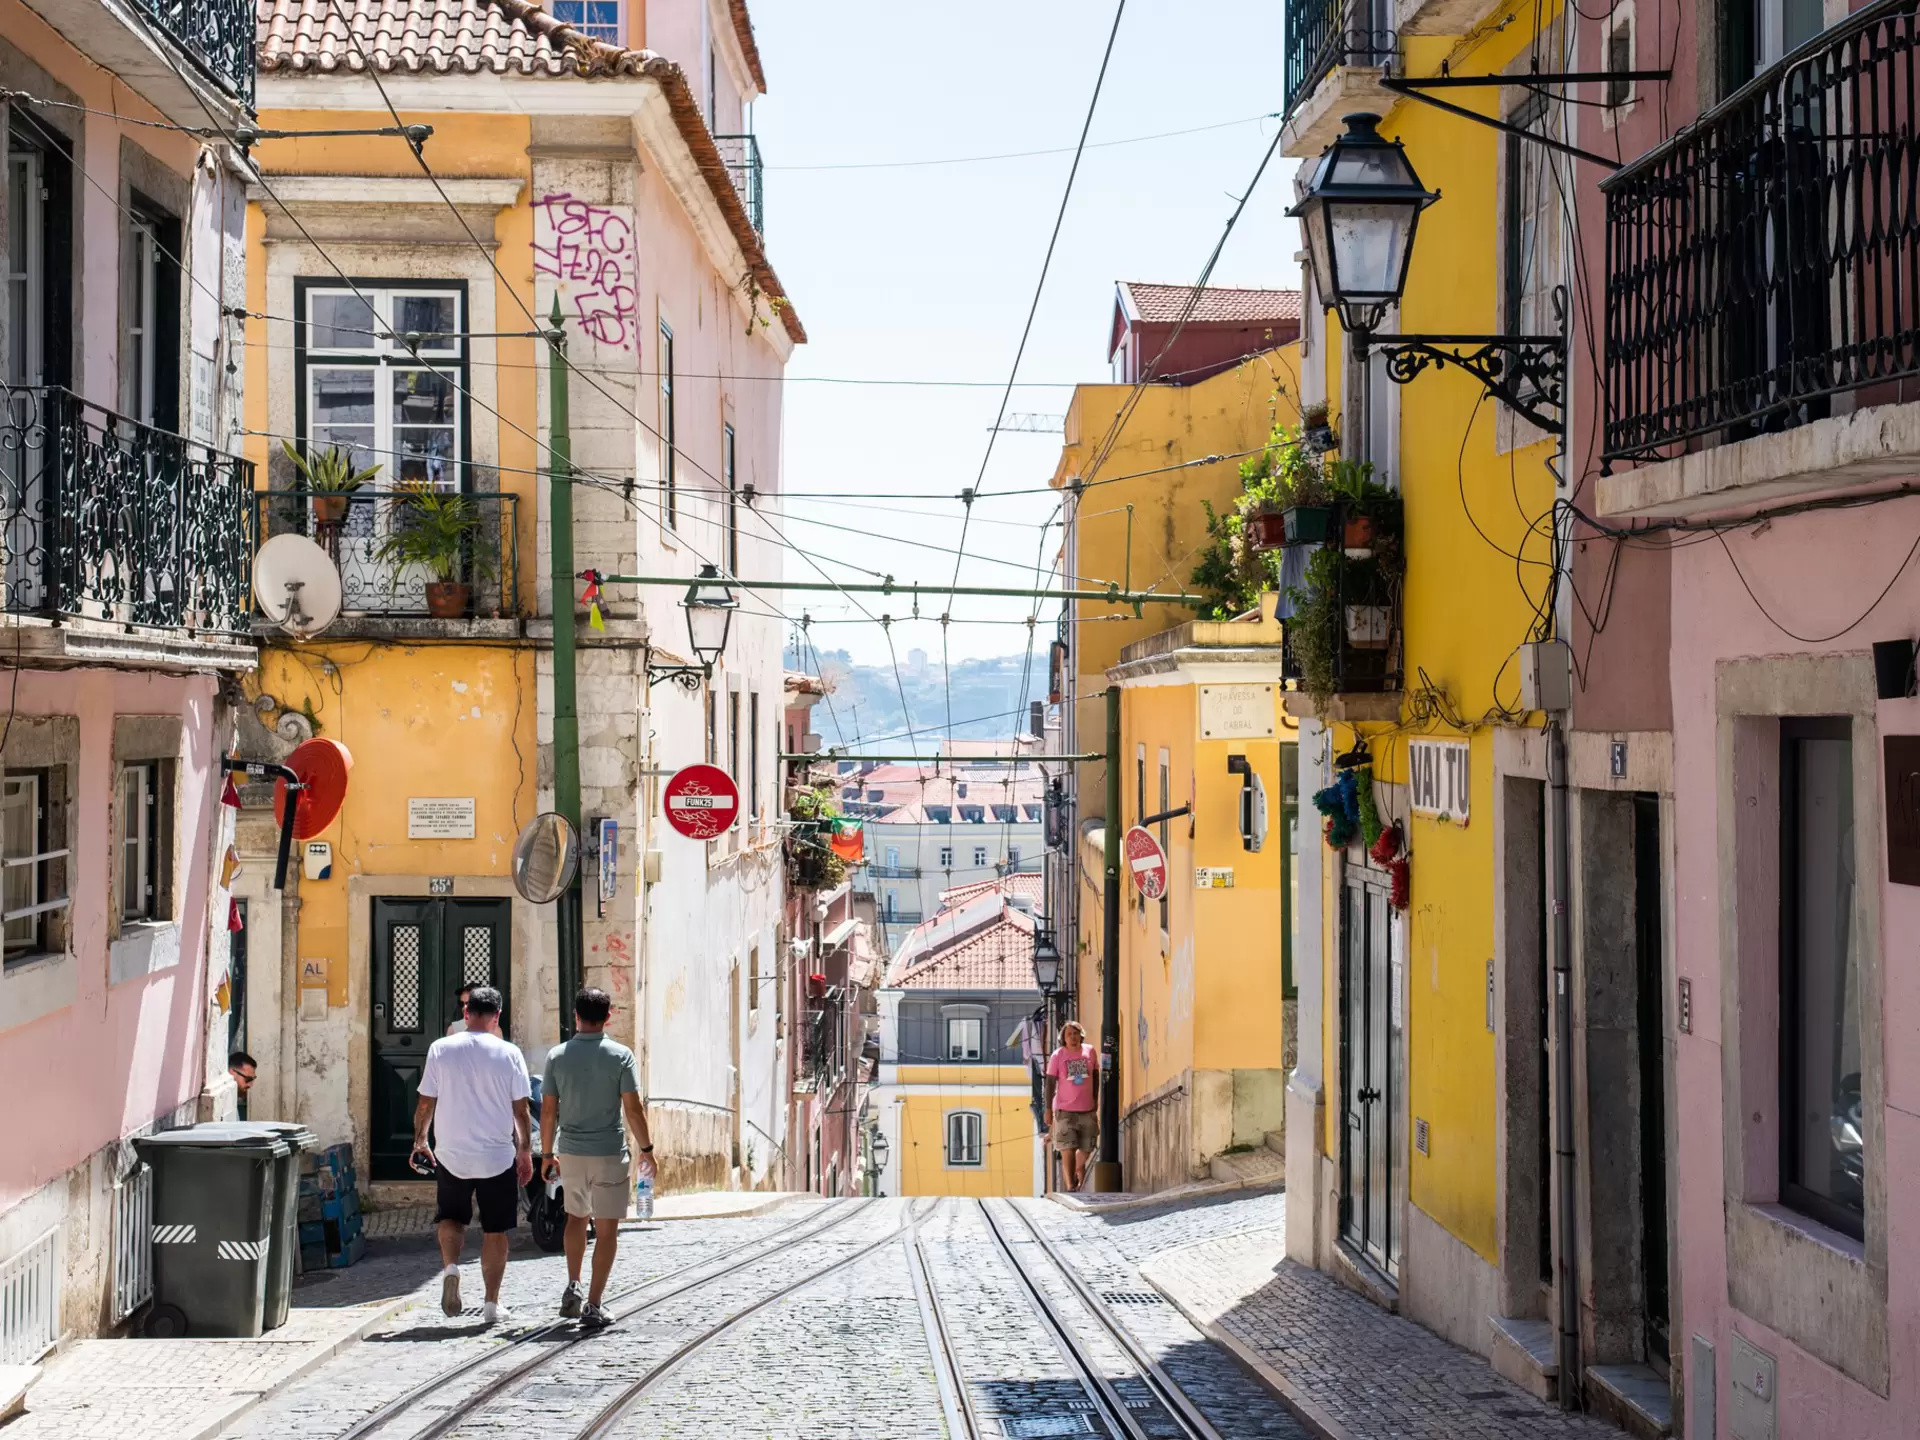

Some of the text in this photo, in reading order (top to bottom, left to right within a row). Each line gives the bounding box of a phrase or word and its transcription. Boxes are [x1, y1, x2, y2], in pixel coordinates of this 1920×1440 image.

[1223, 720, 1252, 730] CABRAL
[1615, 744, 1621, 774] 5
[1409, 745, 1441, 809] VAI
[1446, 747, 1469, 815] TU
[686, 798, 712, 807] FUNK25
[304, 962, 324, 976] AL
